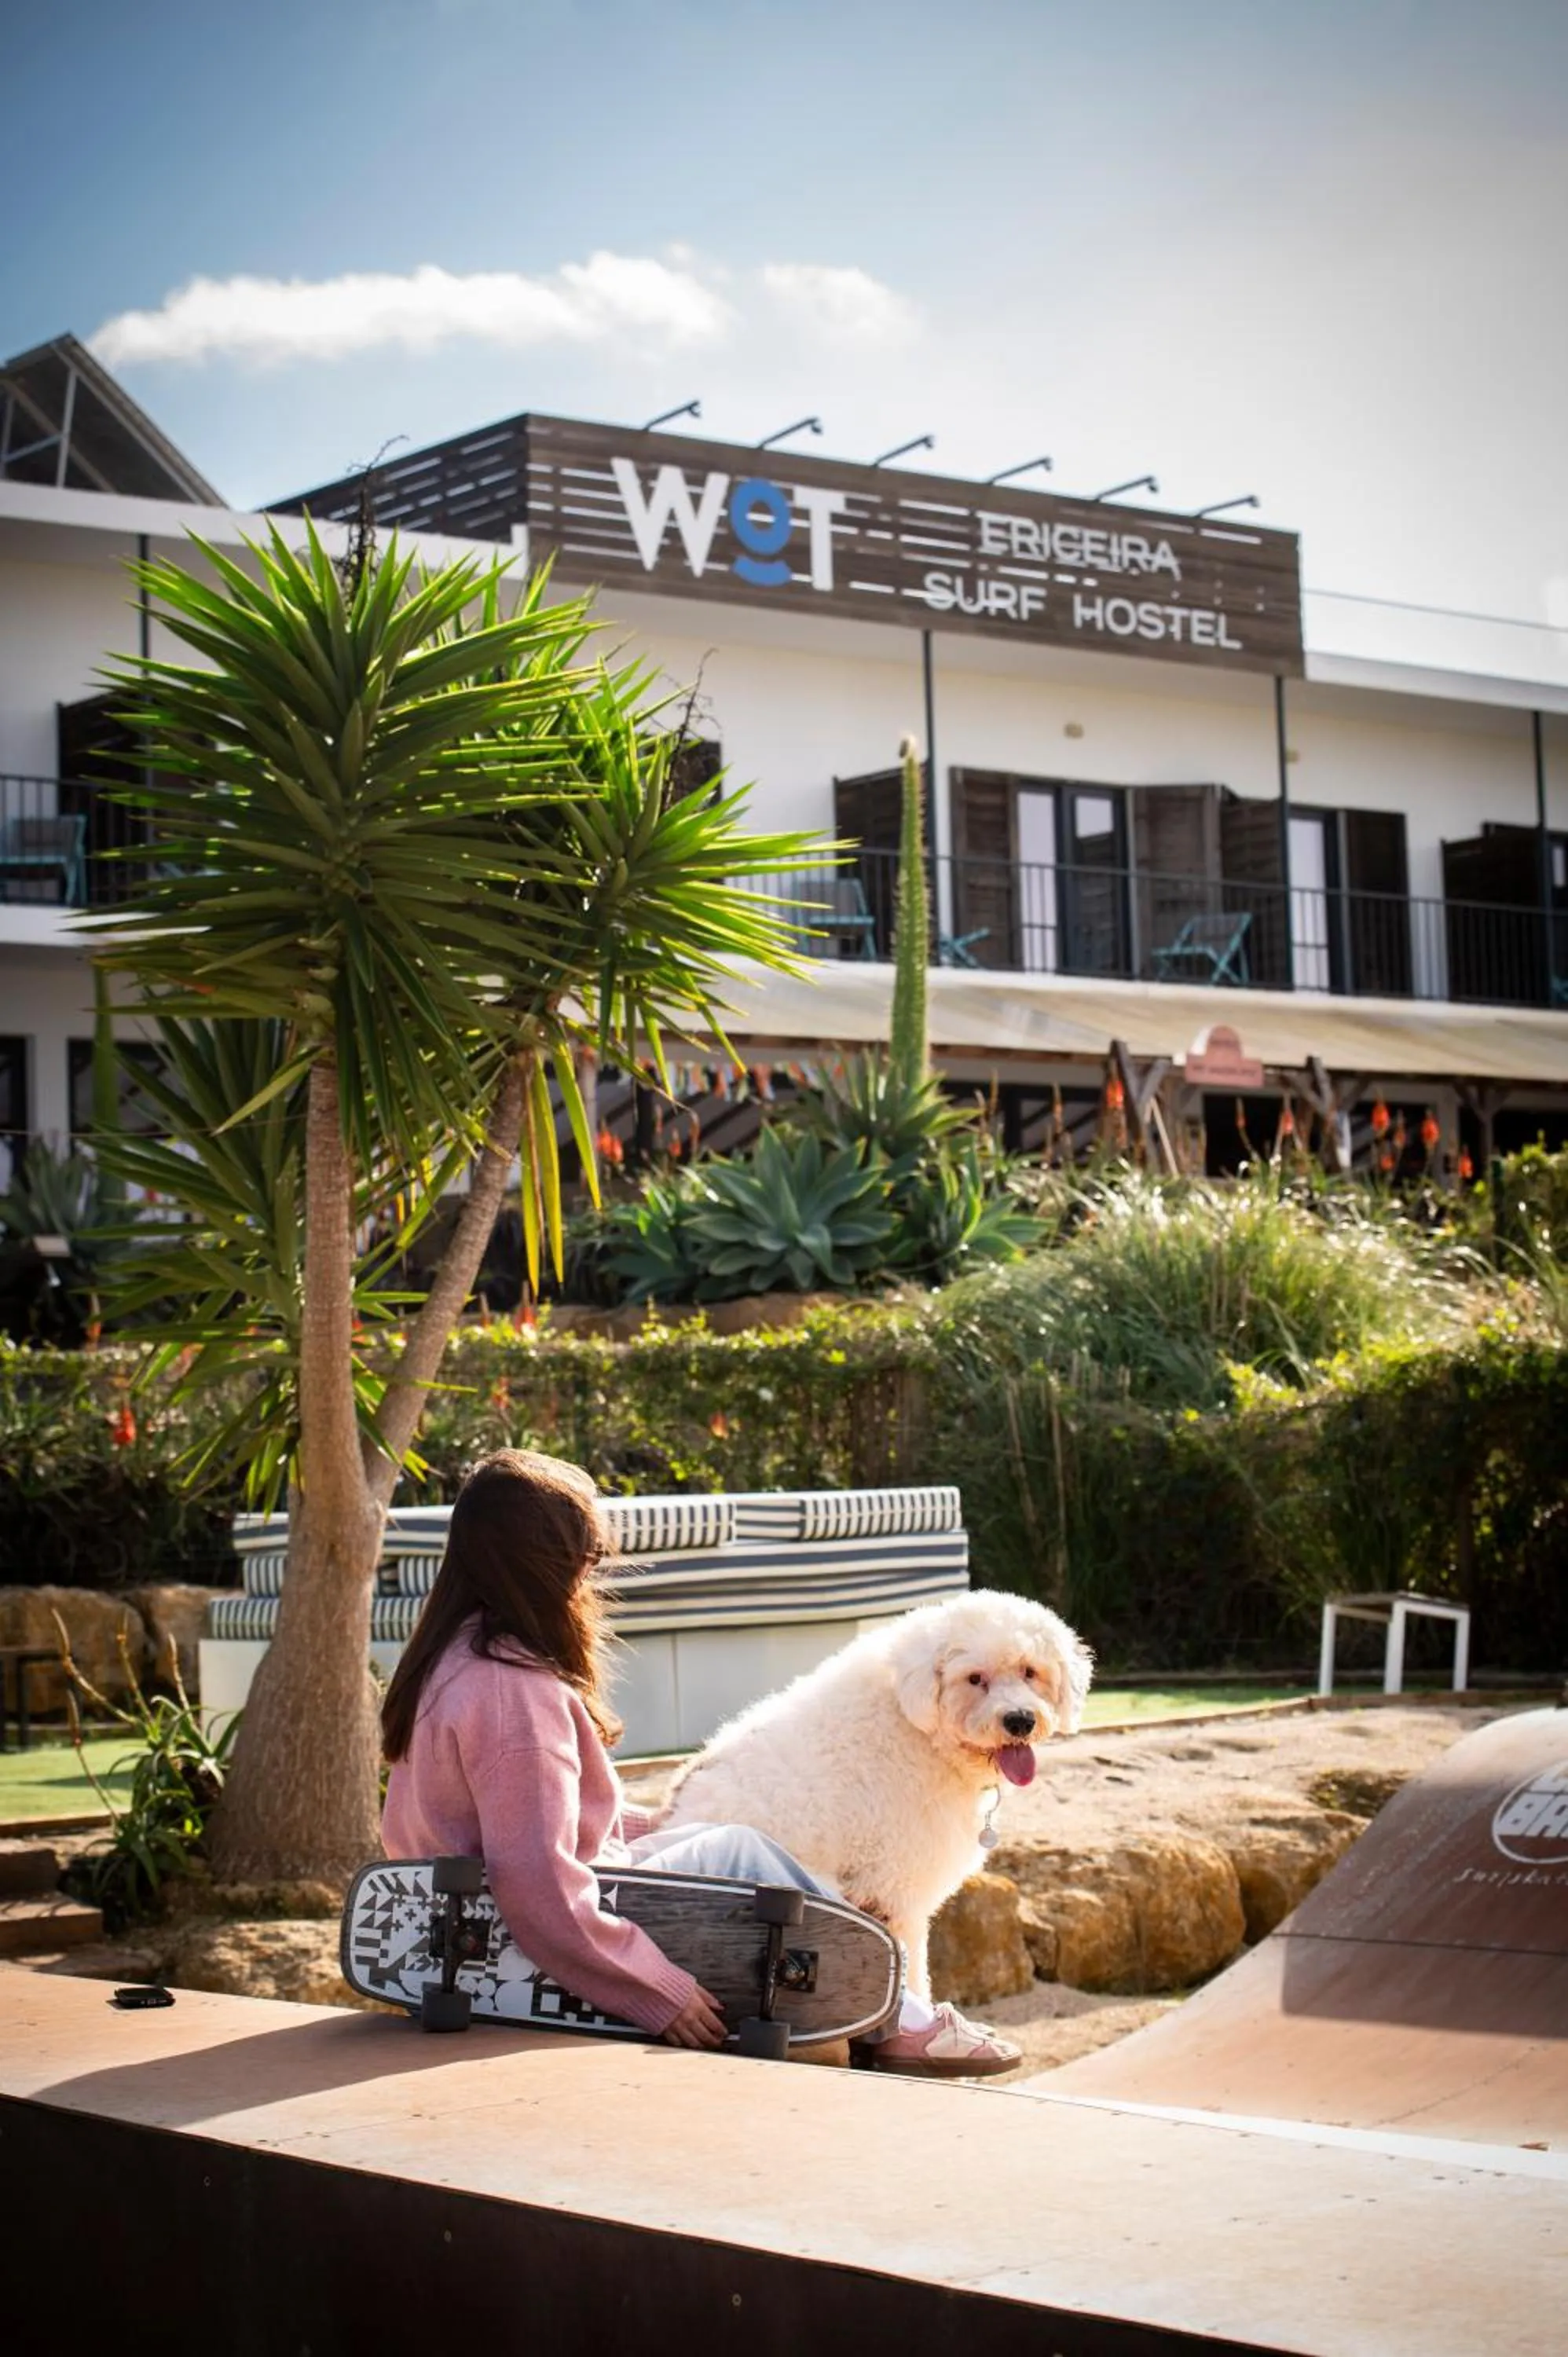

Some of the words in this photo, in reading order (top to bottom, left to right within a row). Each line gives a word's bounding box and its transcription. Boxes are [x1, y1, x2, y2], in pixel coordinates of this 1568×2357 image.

[610, 456, 847, 591] WOT
[977, 511, 1181, 578] ERICEIRA
[923, 571, 1047, 621] SURF
[1072, 593, 1243, 651] HOSTEL
